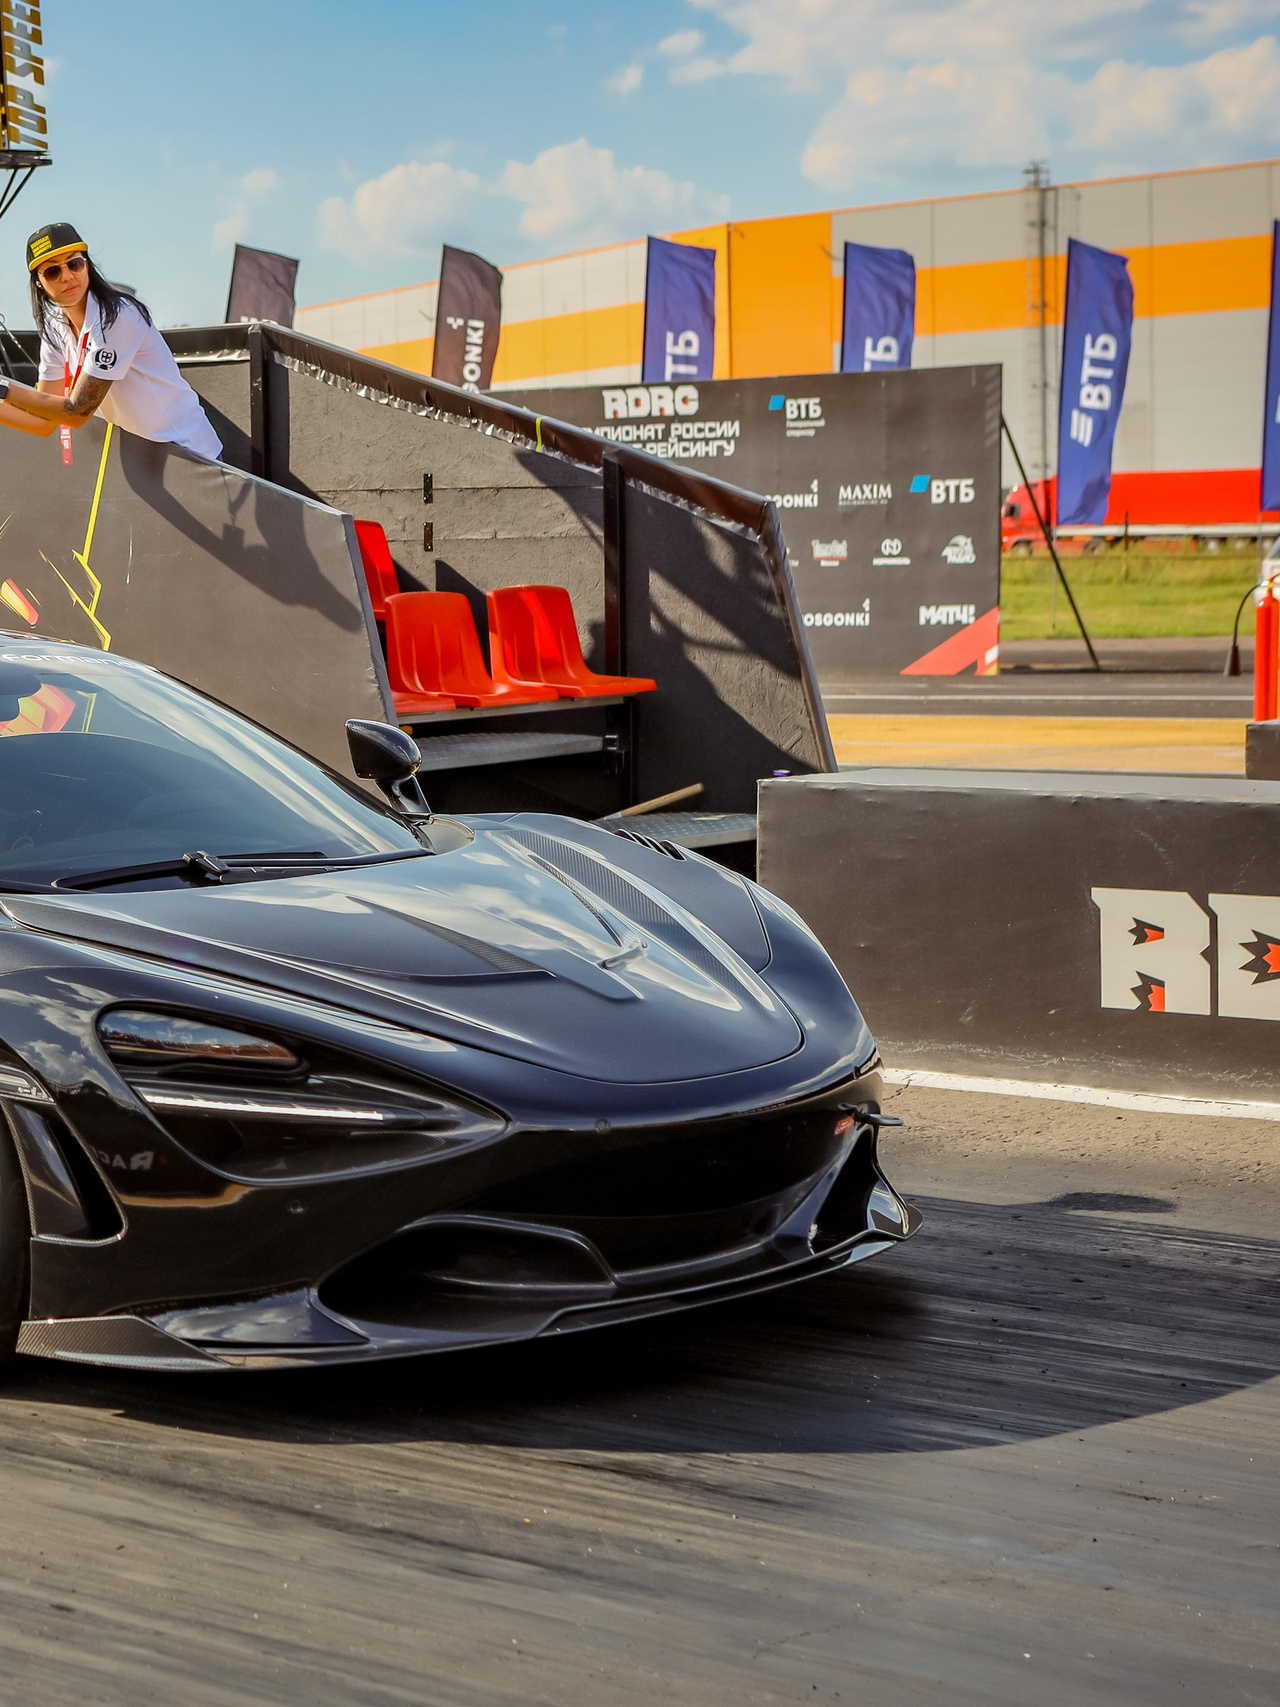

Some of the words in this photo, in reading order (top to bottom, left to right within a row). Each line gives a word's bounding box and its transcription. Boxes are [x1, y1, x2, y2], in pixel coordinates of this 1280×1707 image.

[6, 84, 48, 150] TOP
[665, 330, 699, 380] ТБ
[1079, 333, 1117, 411] ВТБ
[602, 384, 700, 419] RDRC
[785, 396, 822, 420] ВТБ
[583, 423, 665, 442] МПИОНАТ
[670, 420, 740, 439] РОССИИ
[839, 483, 892, 500] MAXIM
[931, 478, 976, 504] ВТБ
[802, 611, 870, 627] OSGONKI
[919, 604, 976, 625] МАТЧ!
